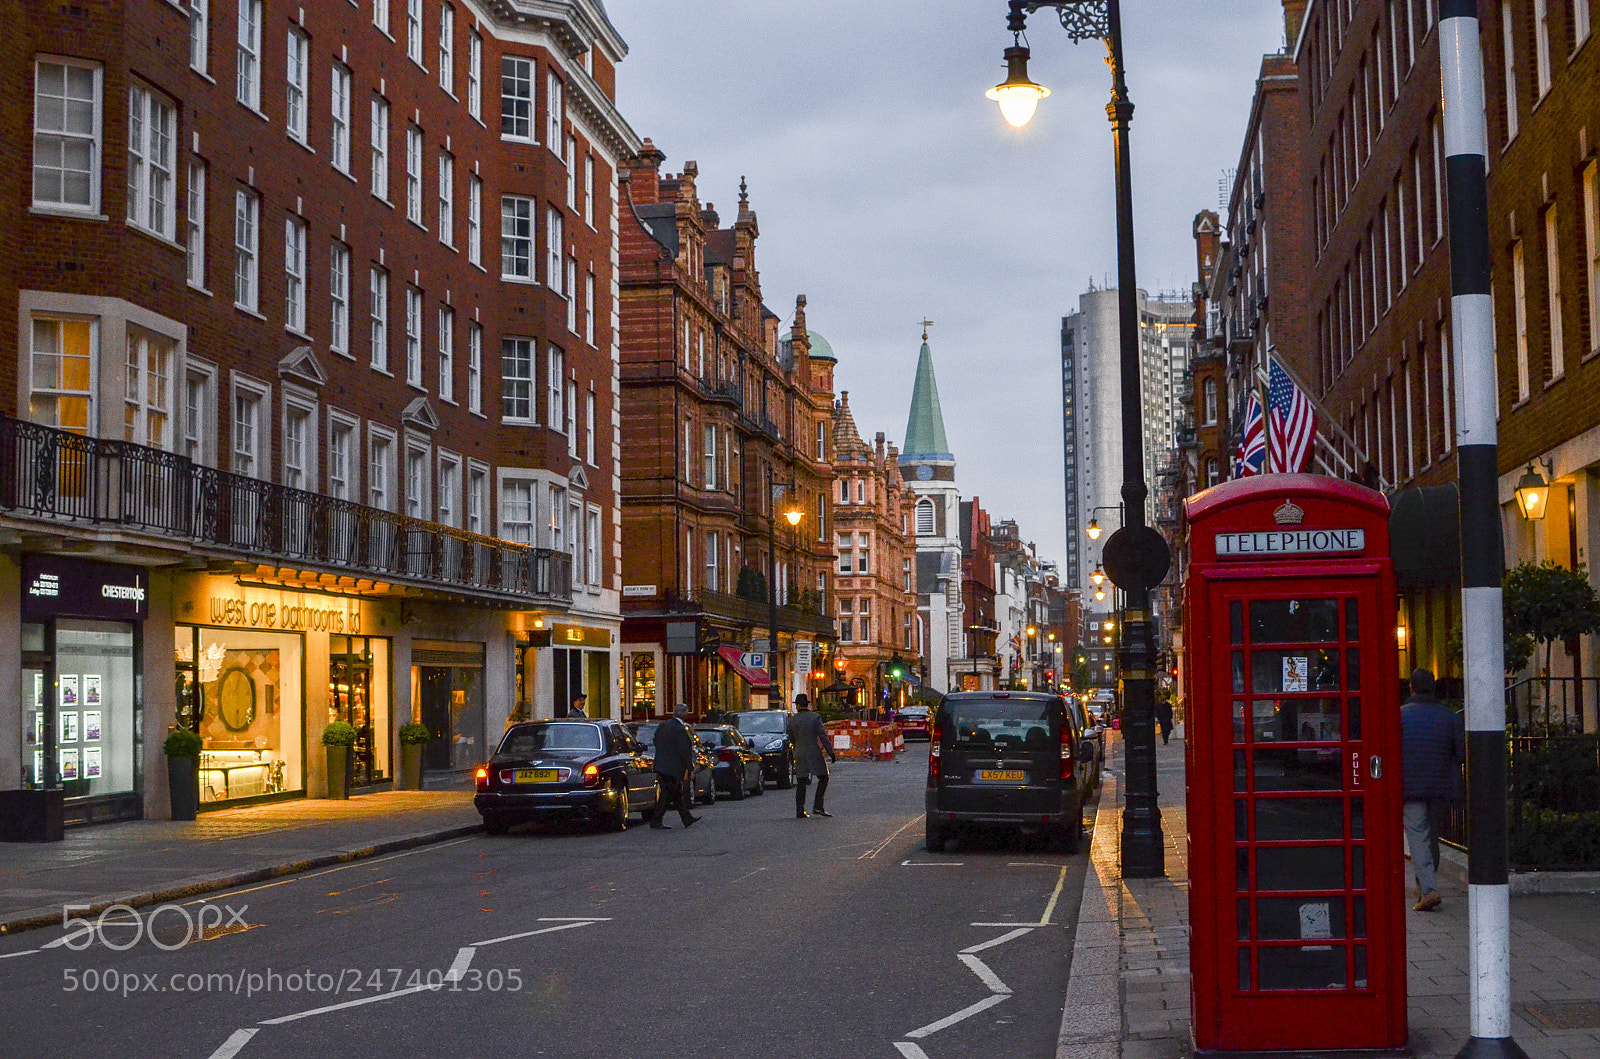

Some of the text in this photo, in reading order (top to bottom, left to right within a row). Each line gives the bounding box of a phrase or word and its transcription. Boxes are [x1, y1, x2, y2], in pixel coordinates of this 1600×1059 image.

[1220, 530, 1359, 552] TELEPHONE
[210, 597, 247, 624] west
[250, 601, 277, 627] one
[281, 604, 344, 632] bathrooms
[753, 656, 761, 665] P
[981, 770, 1004, 779] LX57
